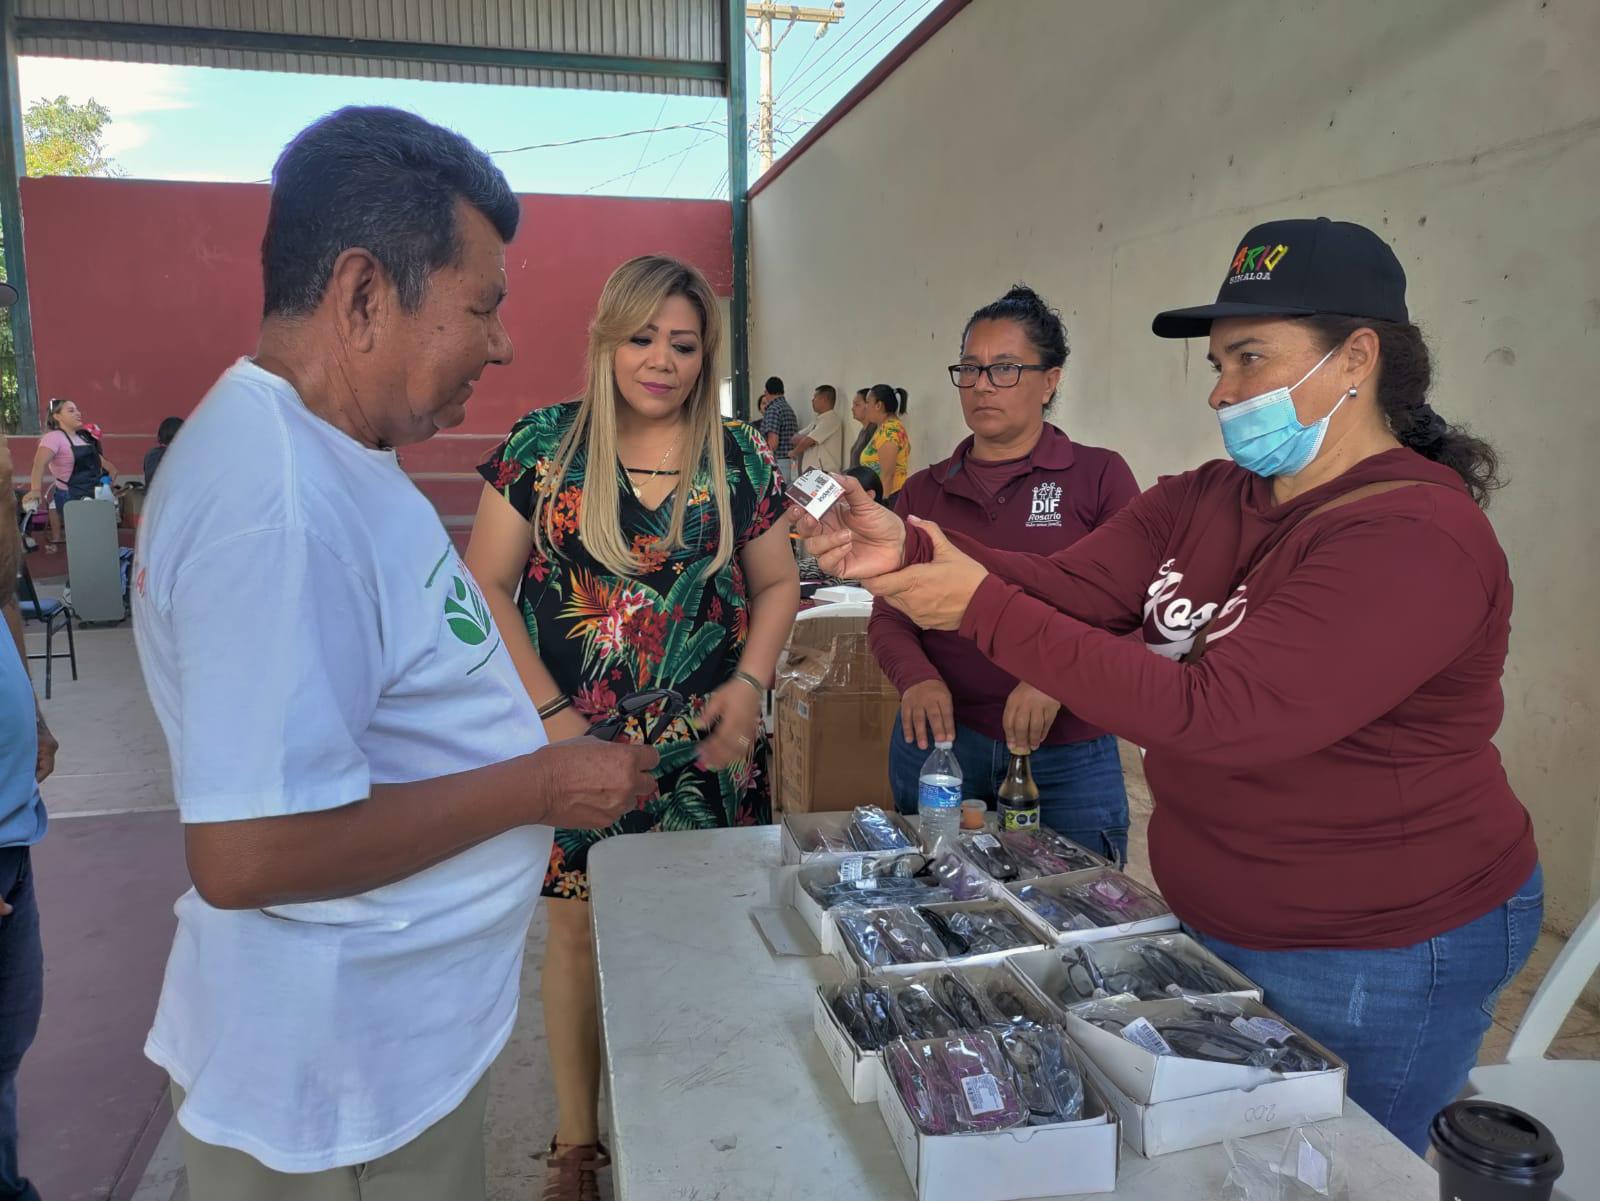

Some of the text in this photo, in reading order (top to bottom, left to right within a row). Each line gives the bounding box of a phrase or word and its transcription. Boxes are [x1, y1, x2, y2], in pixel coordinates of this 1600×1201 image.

[1229, 272, 1271, 285] SINALOA
[1031, 498, 1061, 514] DIF
[1027, 511, 1062, 522] Rosario
